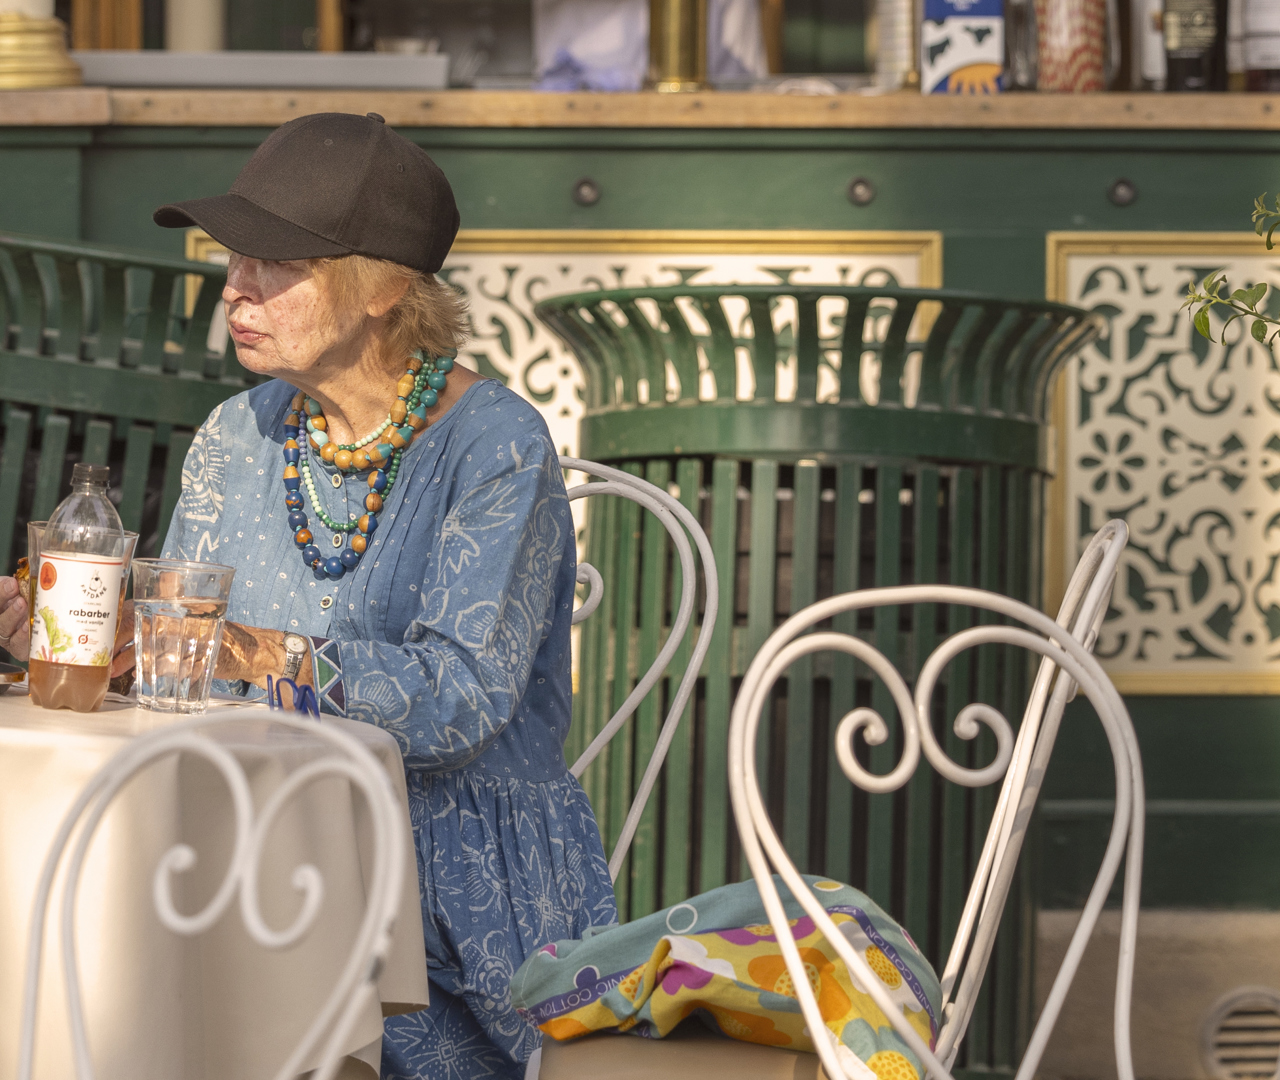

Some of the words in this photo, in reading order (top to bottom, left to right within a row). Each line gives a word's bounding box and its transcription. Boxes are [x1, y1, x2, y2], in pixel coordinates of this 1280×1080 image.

[68, 608, 111, 619] rabarber
[865, 925, 913, 981] COTTON
[539, 987, 592, 1017] COTTON
